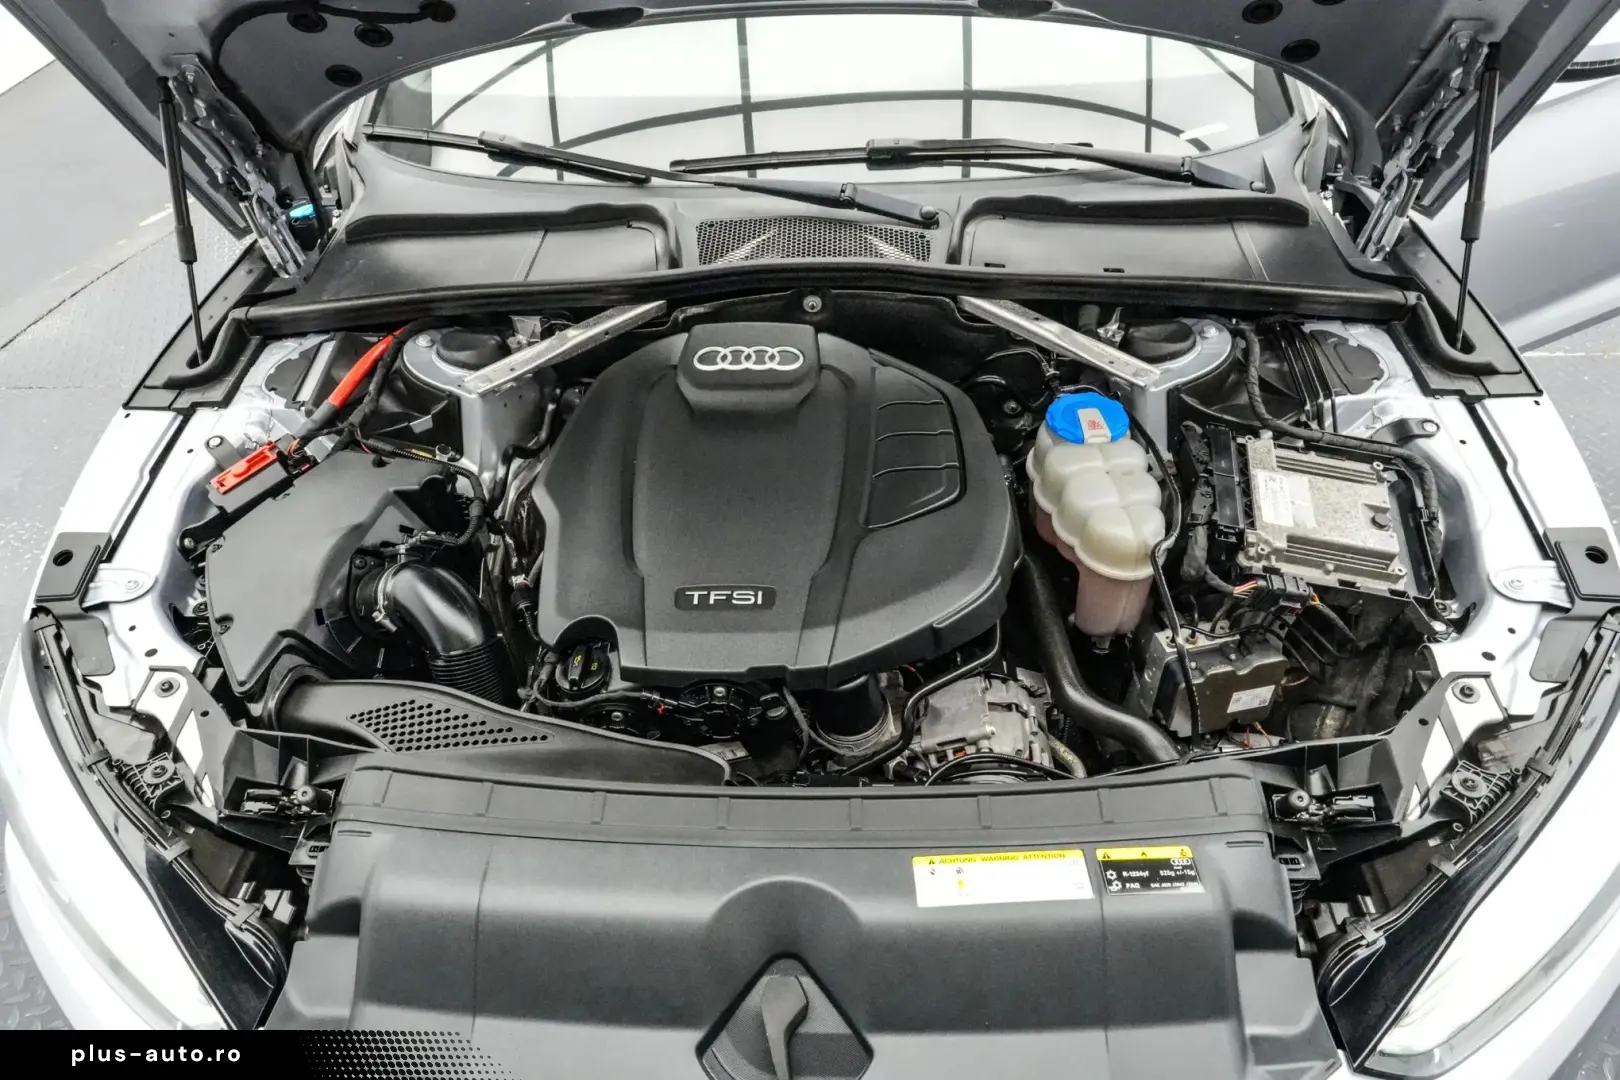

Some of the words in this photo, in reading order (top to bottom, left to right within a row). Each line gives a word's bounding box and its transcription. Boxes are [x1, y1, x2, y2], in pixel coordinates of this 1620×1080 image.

[685, 590, 763, 605] TFSI
[980, 854, 1019, 862] WARNING
[1022, 853, 1066, 861] ATTENTION
